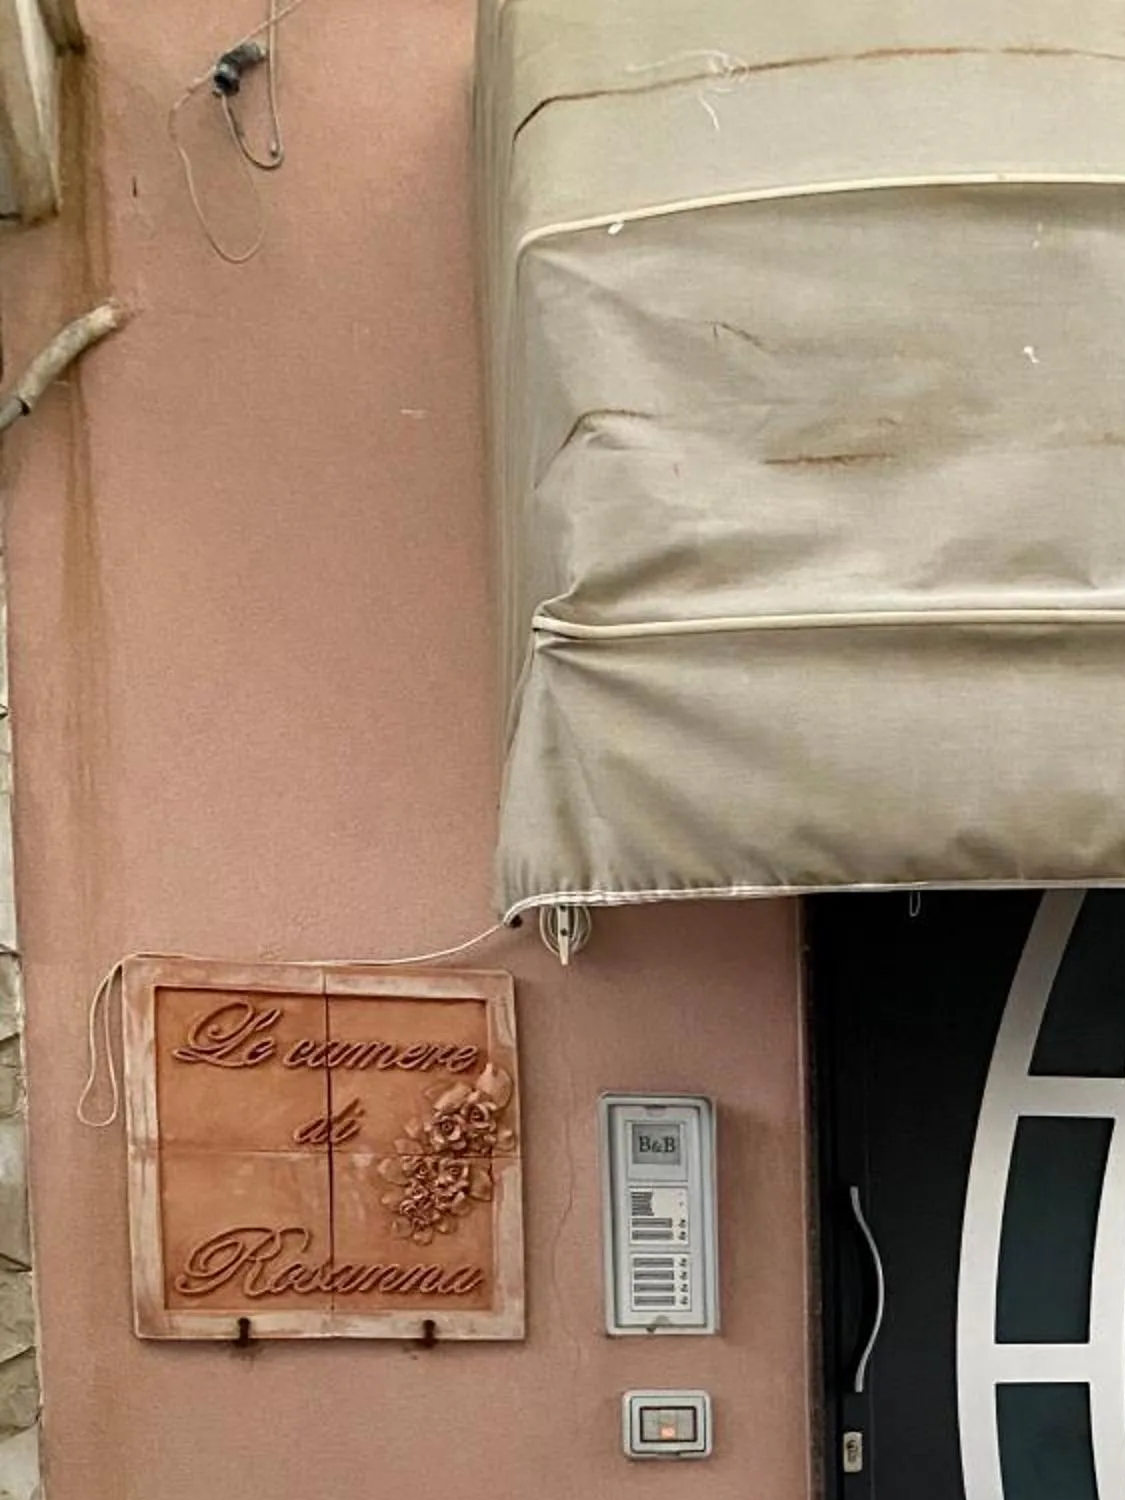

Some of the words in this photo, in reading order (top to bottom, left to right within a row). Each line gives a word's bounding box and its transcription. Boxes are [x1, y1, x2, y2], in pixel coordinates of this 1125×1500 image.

[172, 1000, 284, 1069] Le
[281, 1035, 480, 1074] camere
[292, 1095, 367, 1148] di
[174, 1226, 486, 1301] Rosanna
